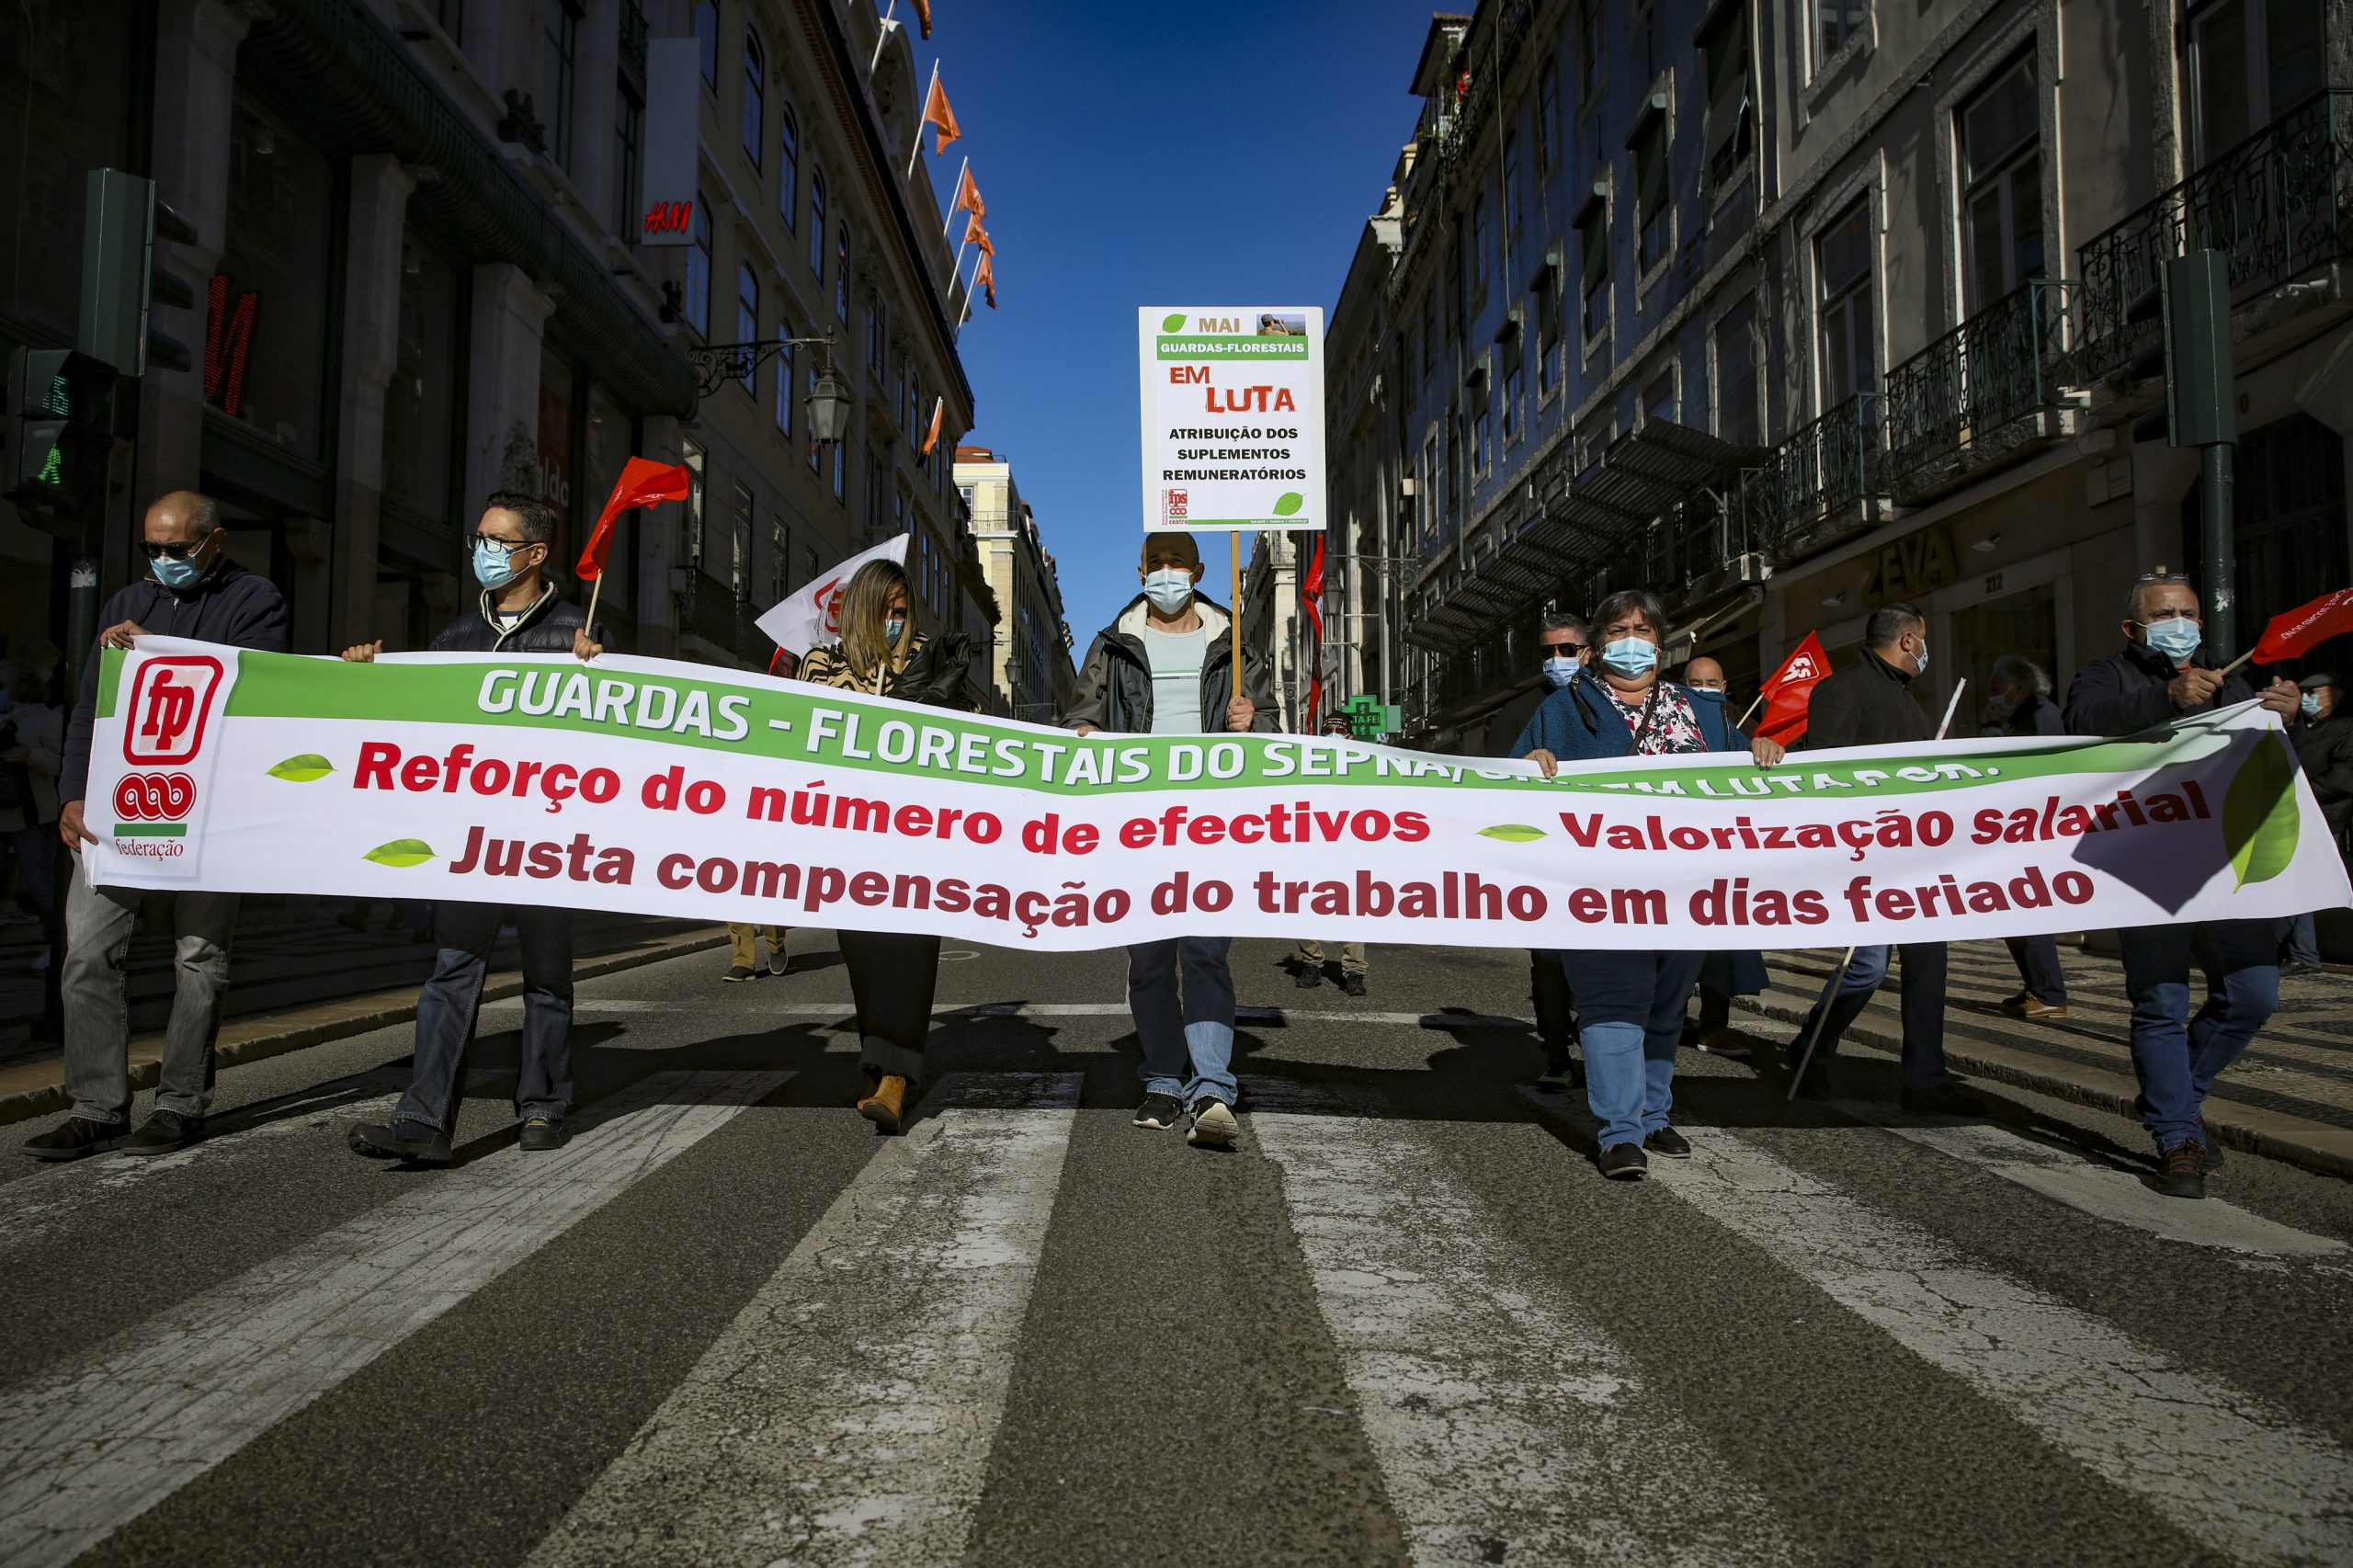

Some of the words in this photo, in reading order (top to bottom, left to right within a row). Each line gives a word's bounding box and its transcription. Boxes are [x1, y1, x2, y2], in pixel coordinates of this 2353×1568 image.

[1199, 318, 1240, 333] MAI
[1160, 343, 1305, 354] GUARDAS-FLORESTAIS
[1170, 366, 1211, 384] EM
[1205, 385, 1296, 413] LUTA
[1169, 426, 1262, 442] ATRIBUIÇÃO
[1267, 428, 1298, 438] DOS
[1177, 449, 1290, 460] SUPLEMENTOS
[1163, 467, 1306, 481] REMUNERATÓRIOS
[1984, 572, 2005, 594] 212
[477, 669, 751, 743] GUARDAS
[805, 707, 1151, 787] FLORESTAIS
[1167, 742, 1245, 782] DO
[354, 742, 620, 813] Reforço
[641, 766, 726, 814] do
[746, 780, 1003, 844] número
[1021, 813, 1100, 855] de
[1119, 801, 1430, 848] efectivos
[1559, 809, 1954, 861] Valorização
[1971, 780, 2211, 845] salarial
[115, 837, 184, 861] federação
[449, 826, 634, 883] Justa
[657, 854, 1131, 937] compensação
[1151, 871, 1233, 915] do
[1254, 870, 1548, 921] trabalho
[1568, 889, 1668, 925] em
[1689, 879, 1829, 926] dias
[1844, 867, 2094, 921] feriado
